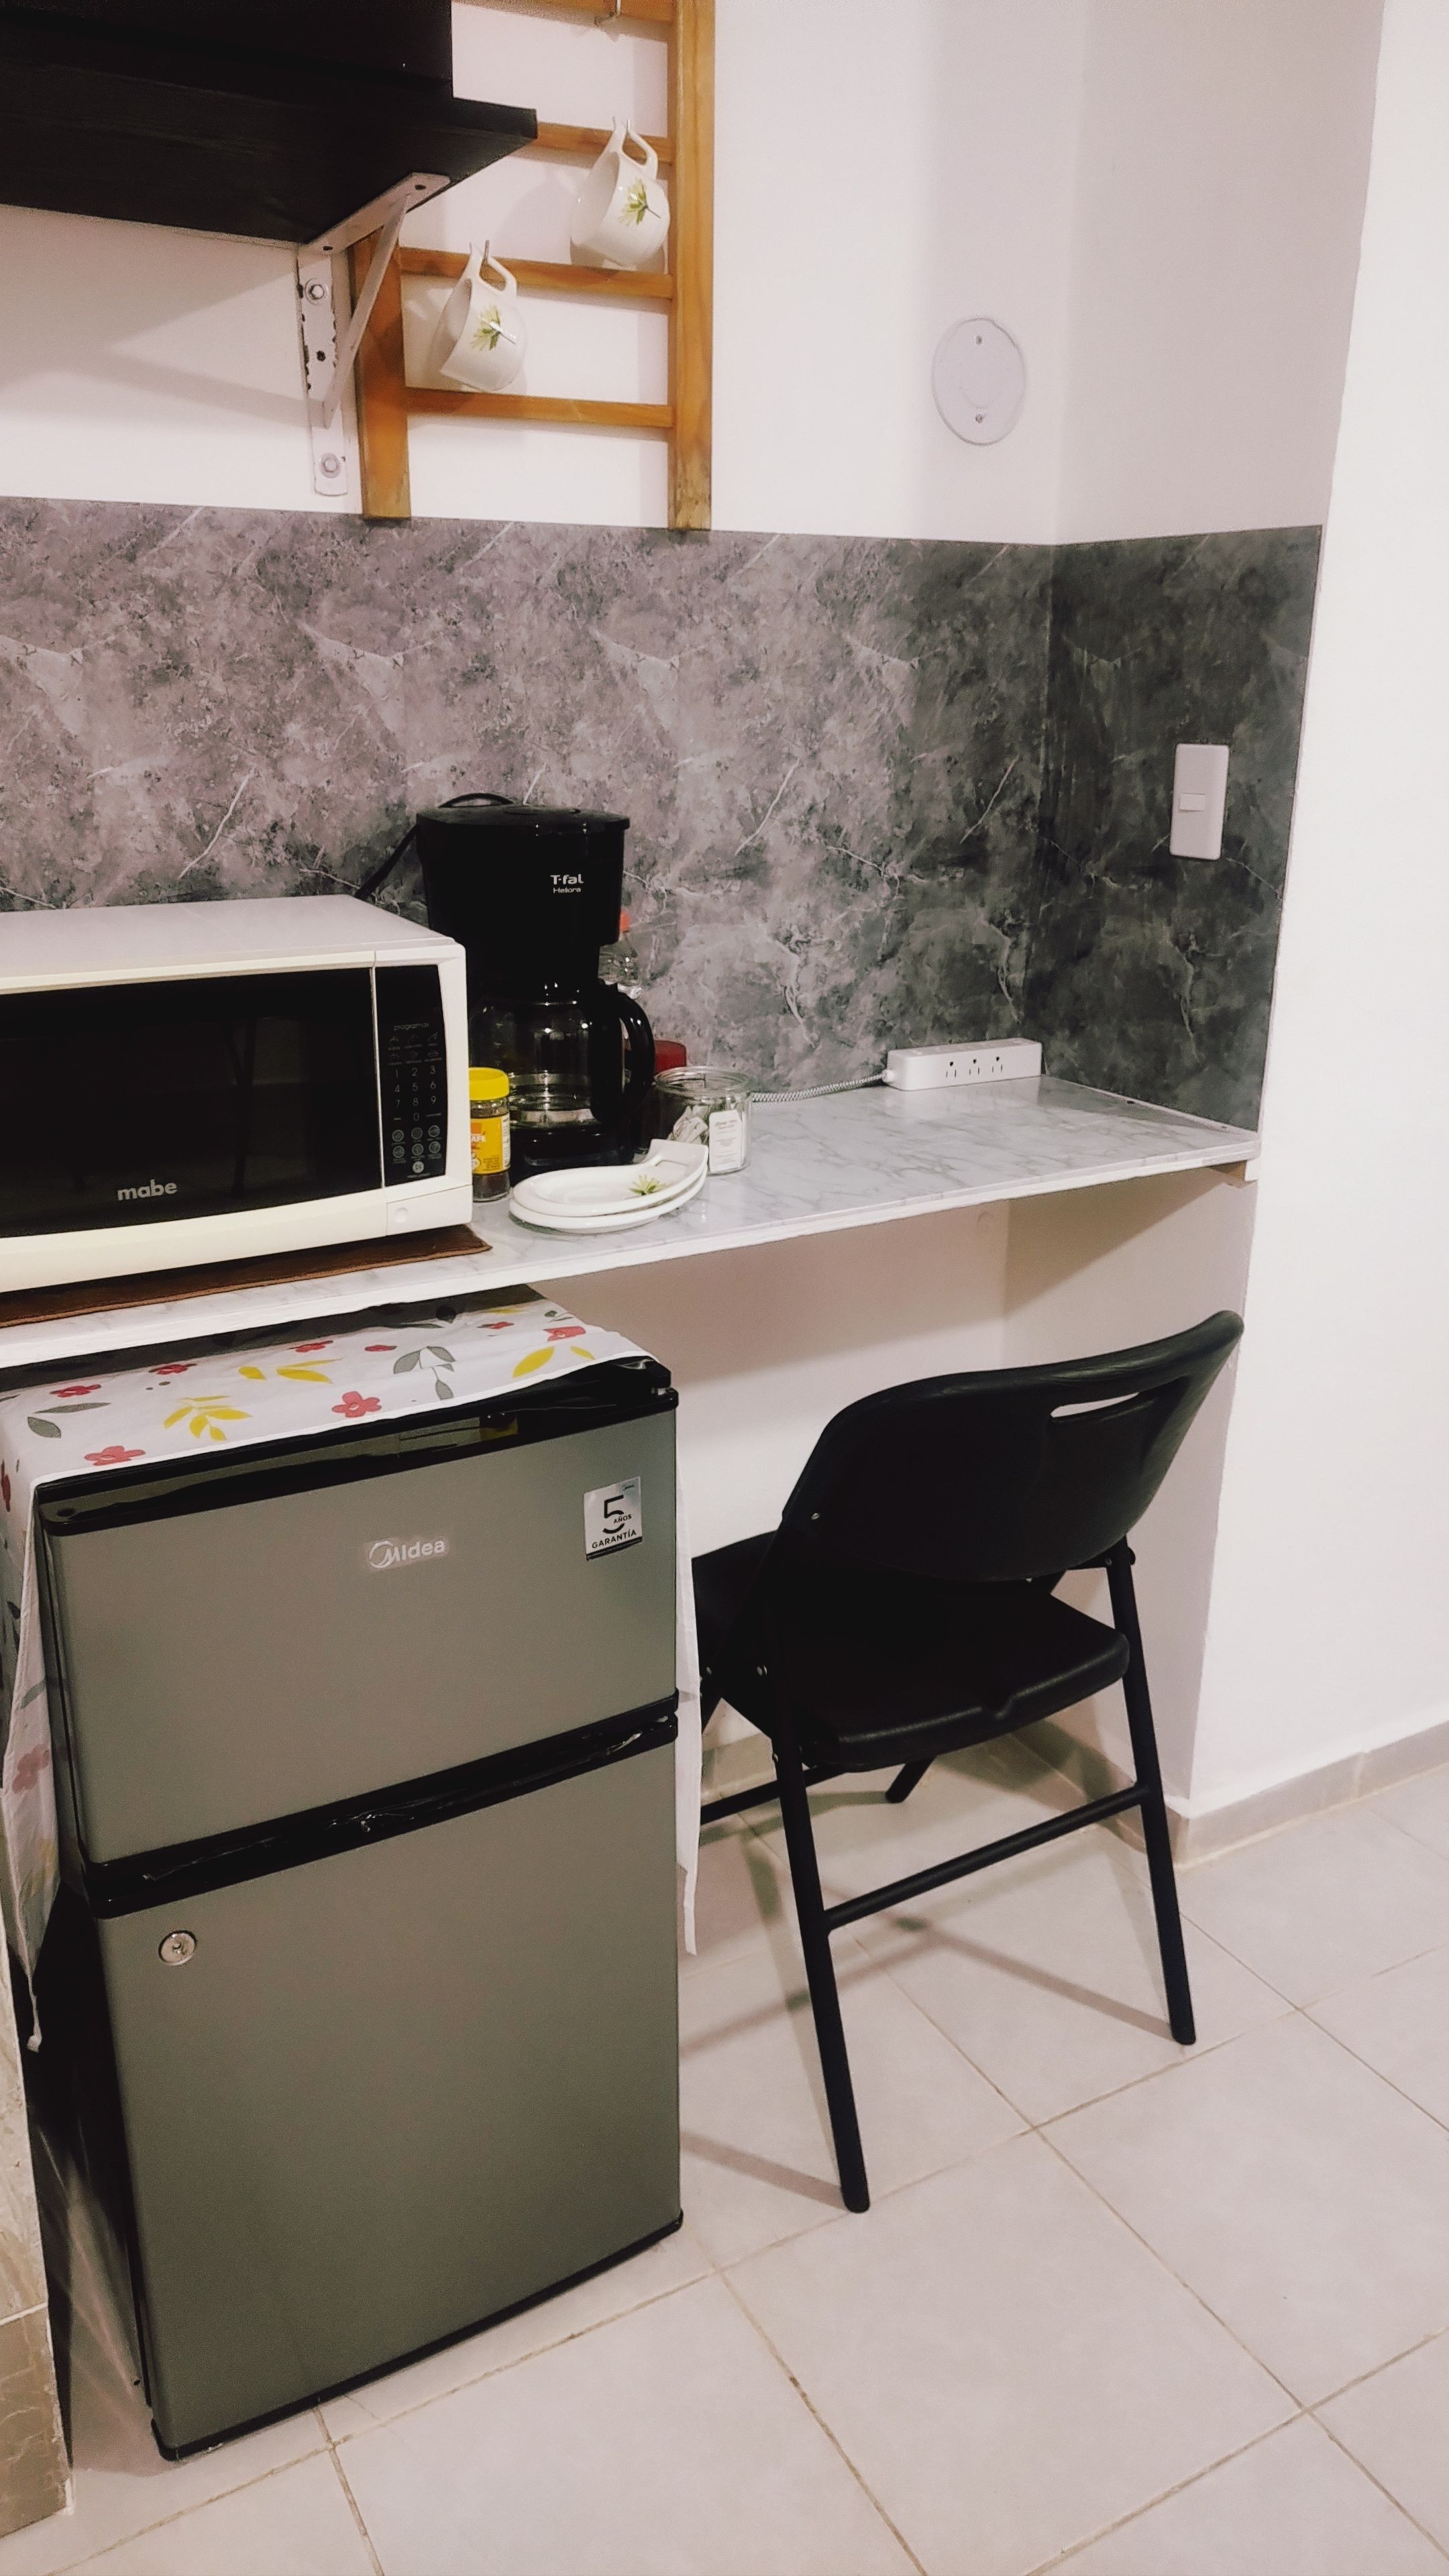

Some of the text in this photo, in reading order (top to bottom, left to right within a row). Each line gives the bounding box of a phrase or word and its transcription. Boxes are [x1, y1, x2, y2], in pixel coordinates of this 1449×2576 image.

[550, 873, 584, 885] T-fal
[394, 1065, 435, 1079] 1 2 3
[394, 1081, 436, 1093] 4 5 6
[395, 1095, 437, 1108] 7 8 9
[413, 1112, 419, 1122] 0
[117, 1179, 178, 1201] mabe
[602, 1495, 625, 1534] 5
[613, 1513, 632, 1524] AÑOS
[592, 1529, 637, 1549] GARANTÍA
[369, 1540, 446, 1568] Midea
